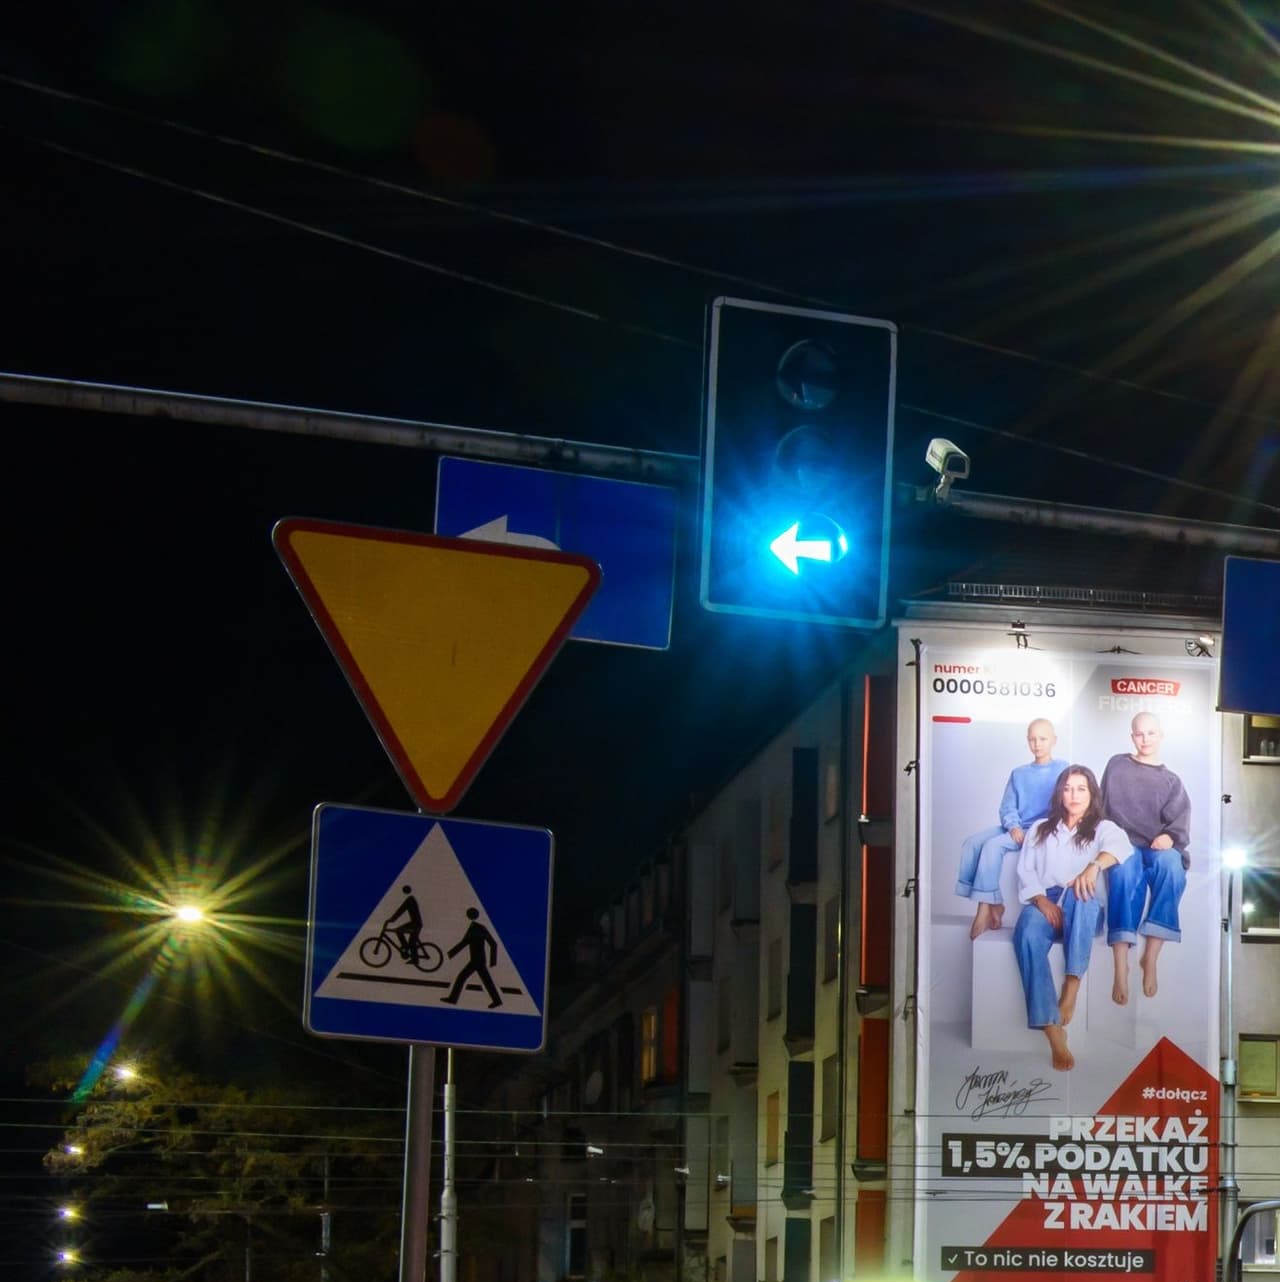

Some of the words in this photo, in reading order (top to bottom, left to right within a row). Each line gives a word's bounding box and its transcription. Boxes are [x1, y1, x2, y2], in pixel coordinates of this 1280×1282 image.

[933, 663, 981, 674] numer
[932, 677, 1056, 698] 0000581036
[1116, 680, 1175, 694] CANCER
[1142, 1087, 1208, 1103] #dołącz
[1050, 1109, 1209, 1143] PRZEKAŻ
[947, 1140, 1031, 1173] 1,5%
[1035, 1142, 1209, 1174] PODATKU
[1022, 1173, 1077, 1200] NA
[1043, 1202, 1065, 1229] Z
[1070, 1202, 1208, 1232] RAKIEM
[964, 1250, 988, 1266] To
[993, 1251, 1022, 1267] nic
[1028, 1252, 1059, 1268] nie
[1063, 1252, 1144, 1272] kosztuje
